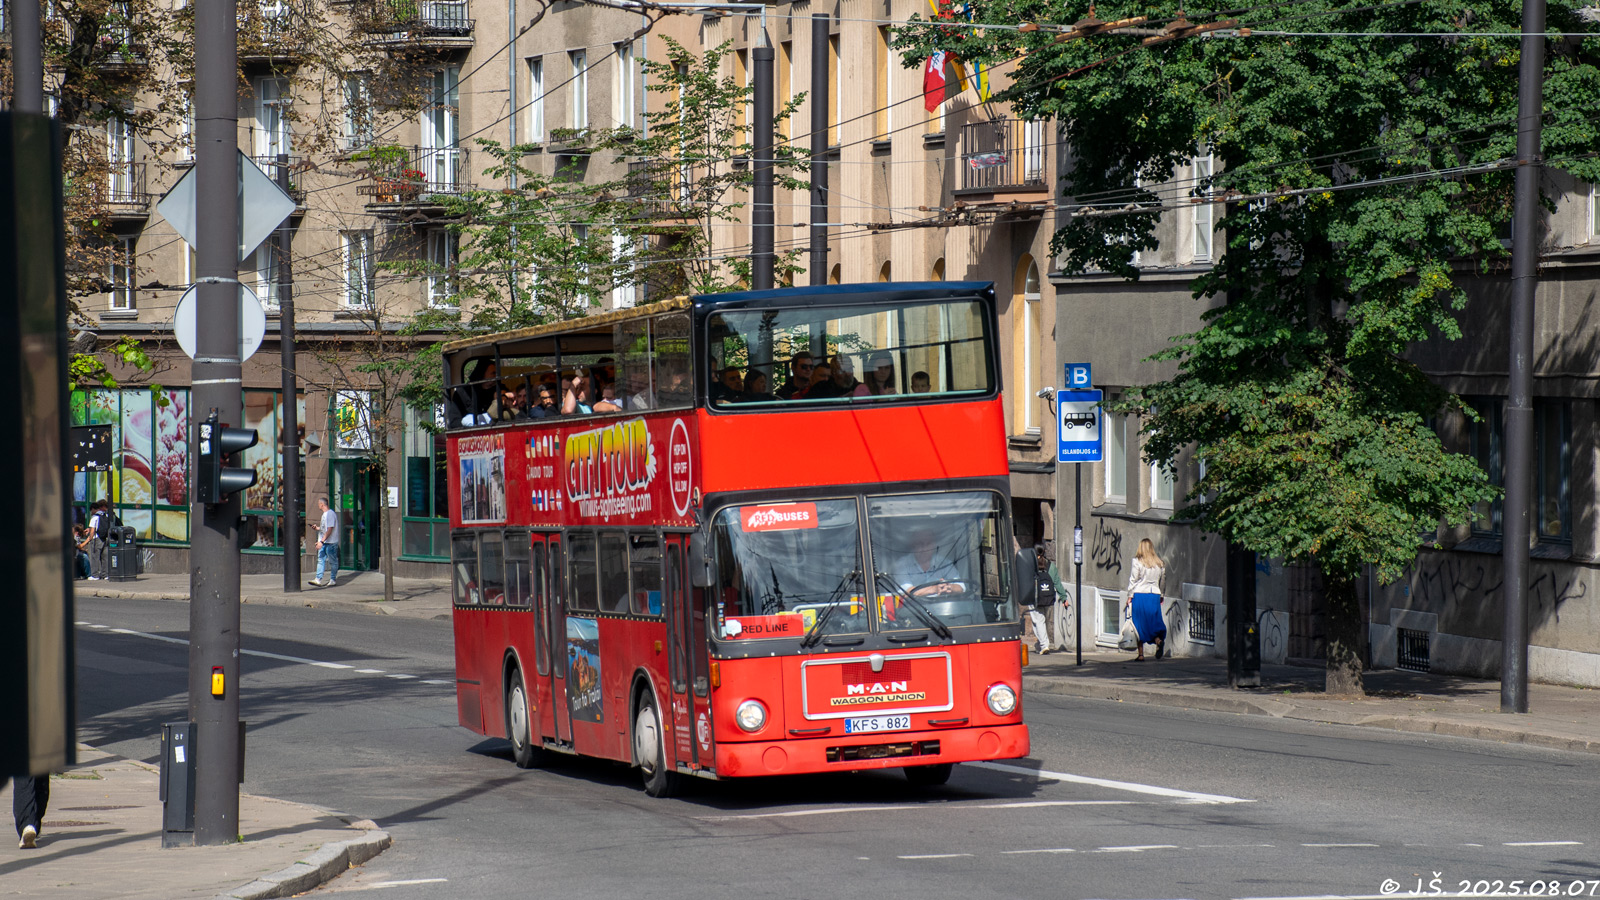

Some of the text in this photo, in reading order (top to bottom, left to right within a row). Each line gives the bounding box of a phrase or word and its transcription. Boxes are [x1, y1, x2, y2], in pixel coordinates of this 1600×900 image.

[1073, 367, 1088, 385] B
[681, 444, 686, 455] ON
[565, 417, 649, 503] CITY TOUR
[530, 465, 553, 478] AUDIO TOUR
[742, 623, 789, 634] RED LINE
[832, 692, 925, 706] WAGGON UNION
[852, 719, 878, 732] KFS
[887, 717, 909, 729] 882
